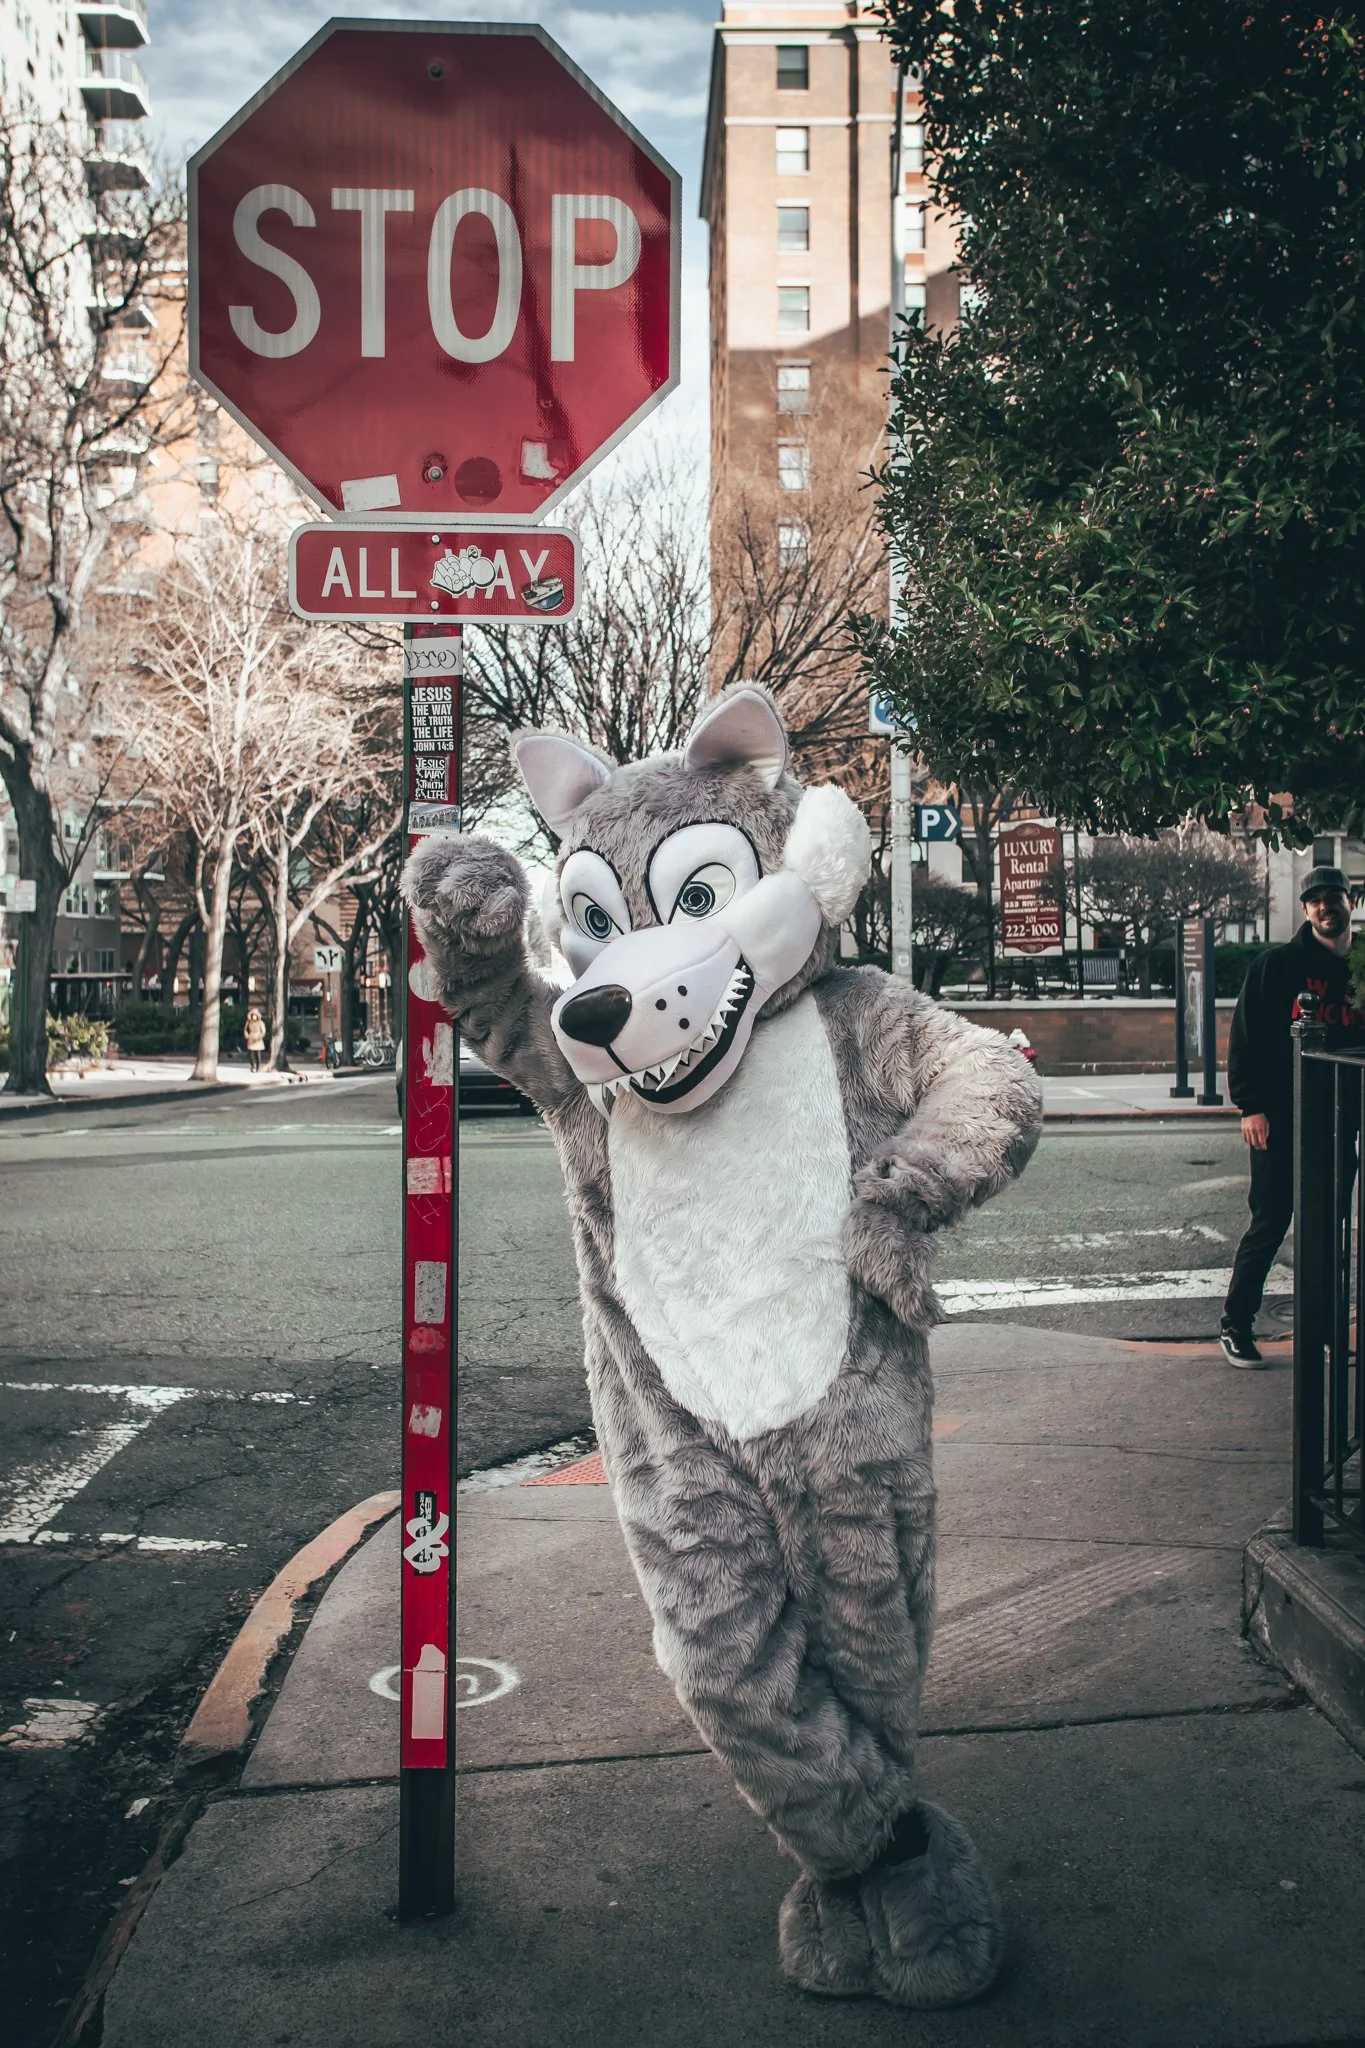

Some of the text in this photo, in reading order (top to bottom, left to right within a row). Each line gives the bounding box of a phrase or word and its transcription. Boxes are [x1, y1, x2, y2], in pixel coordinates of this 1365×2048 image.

[228, 183, 642, 364] STOP
[321, 546, 418, 599] ALL
[411, 686, 452, 702] JESUS
[411, 703, 452, 716] THE WAY
[412, 715, 453, 726] THE TRUTH
[413, 726, 453, 738] THE LIFE
[413, 741, 454, 751] JOHN 14:6
[922, 809, 940, 838] P
[1004, 839, 1055, 857] LUXURY
[1010, 856, 1049, 874] Rental
[1025, 915, 1037, 924] 201
[1006, 923, 1058, 937] 222-1000
